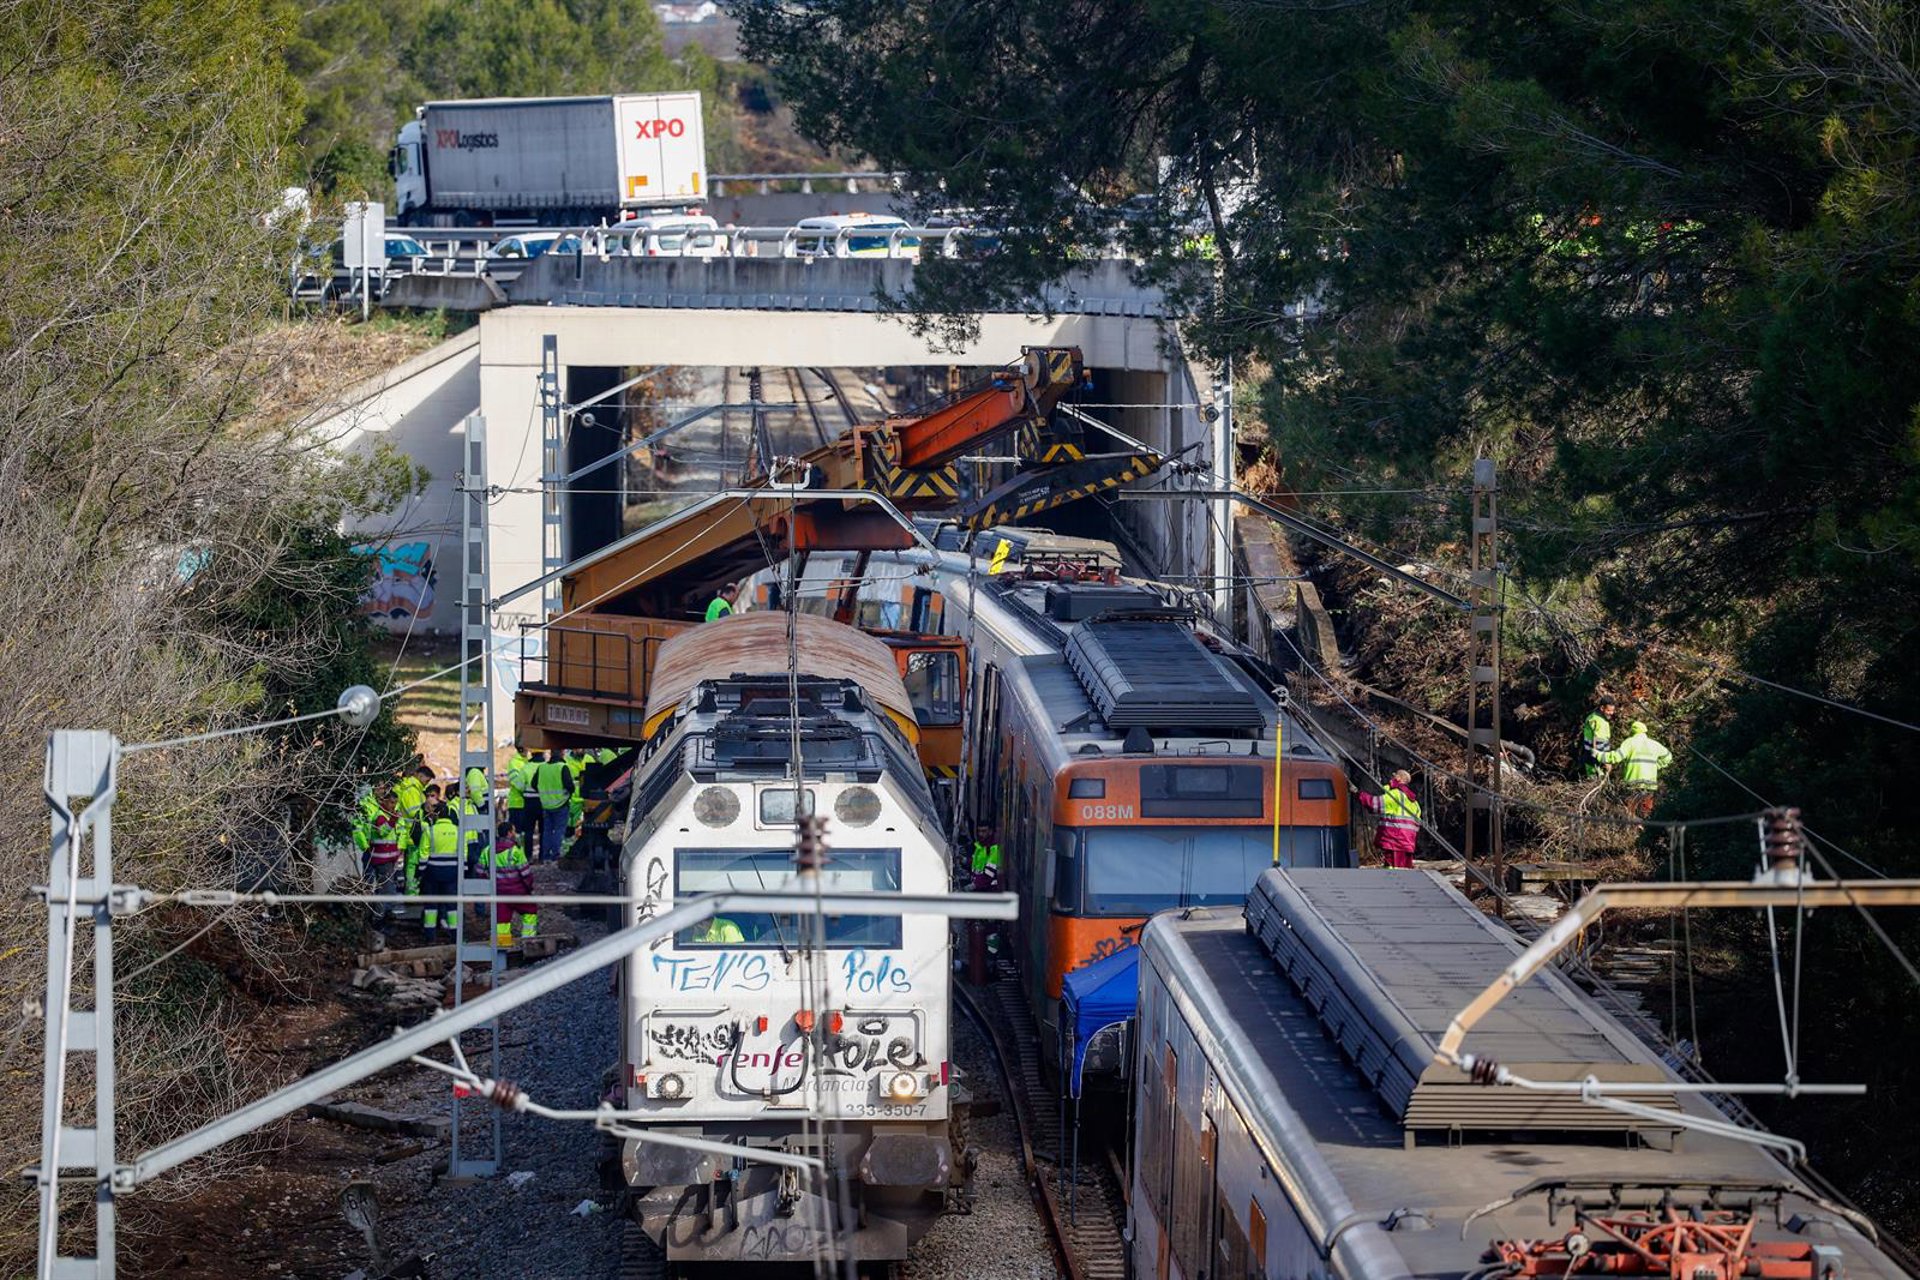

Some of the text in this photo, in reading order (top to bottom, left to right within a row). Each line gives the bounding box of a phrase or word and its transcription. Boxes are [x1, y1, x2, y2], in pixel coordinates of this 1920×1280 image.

[635, 118, 684, 139] XPO
[1082, 804, 1134, 820] 088M
[716, 1043, 804, 1076] renfe
